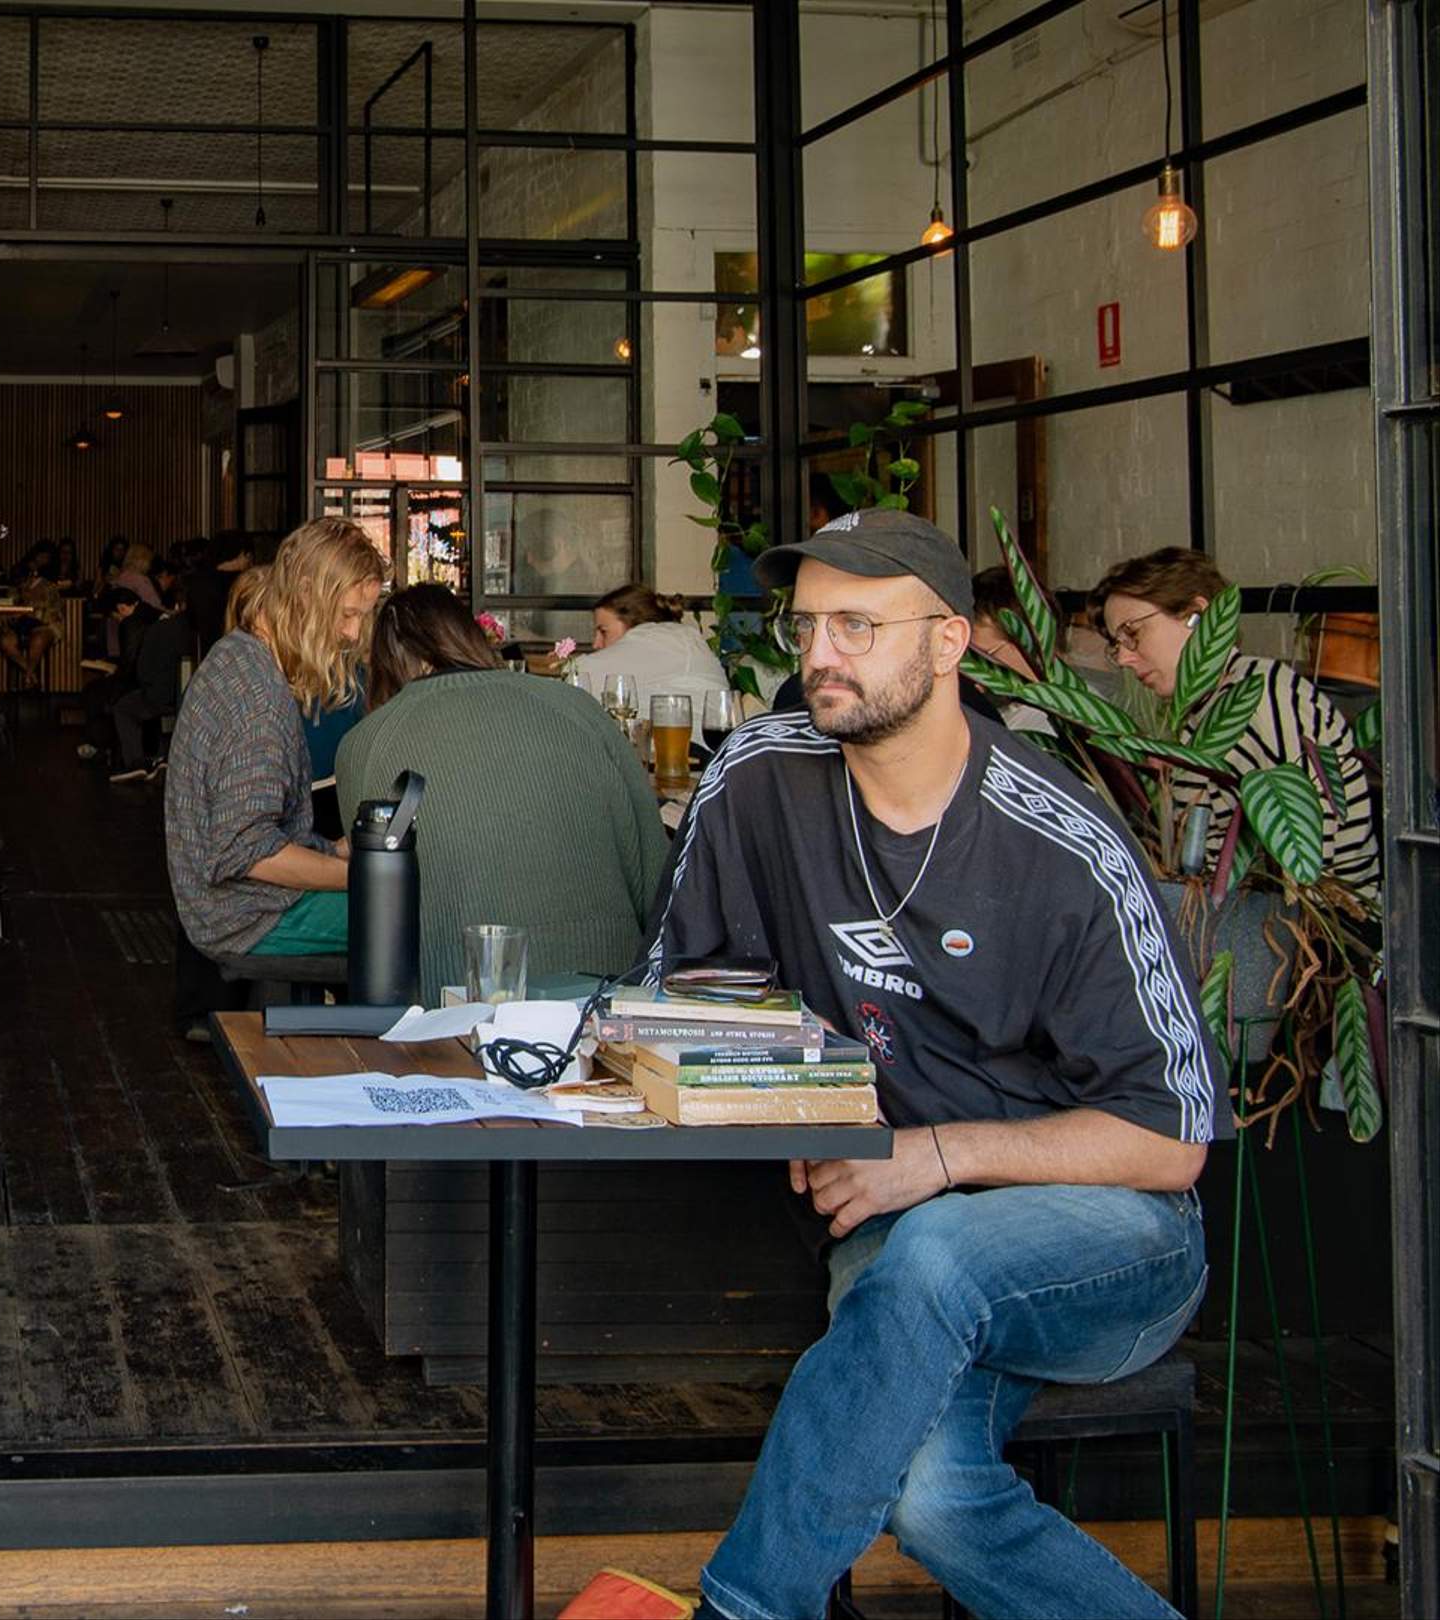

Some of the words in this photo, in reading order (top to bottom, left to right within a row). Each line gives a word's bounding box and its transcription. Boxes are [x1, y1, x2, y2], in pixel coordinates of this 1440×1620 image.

[837, 952, 923, 1000] MBRO
[638, 1028, 705, 1037] METAMORPHOSIS
[749, 1031, 776, 1039] STORIES
[700, 1075, 740, 1083] ENGLISH
[741, 1074, 800, 1083] DICTIONARY
